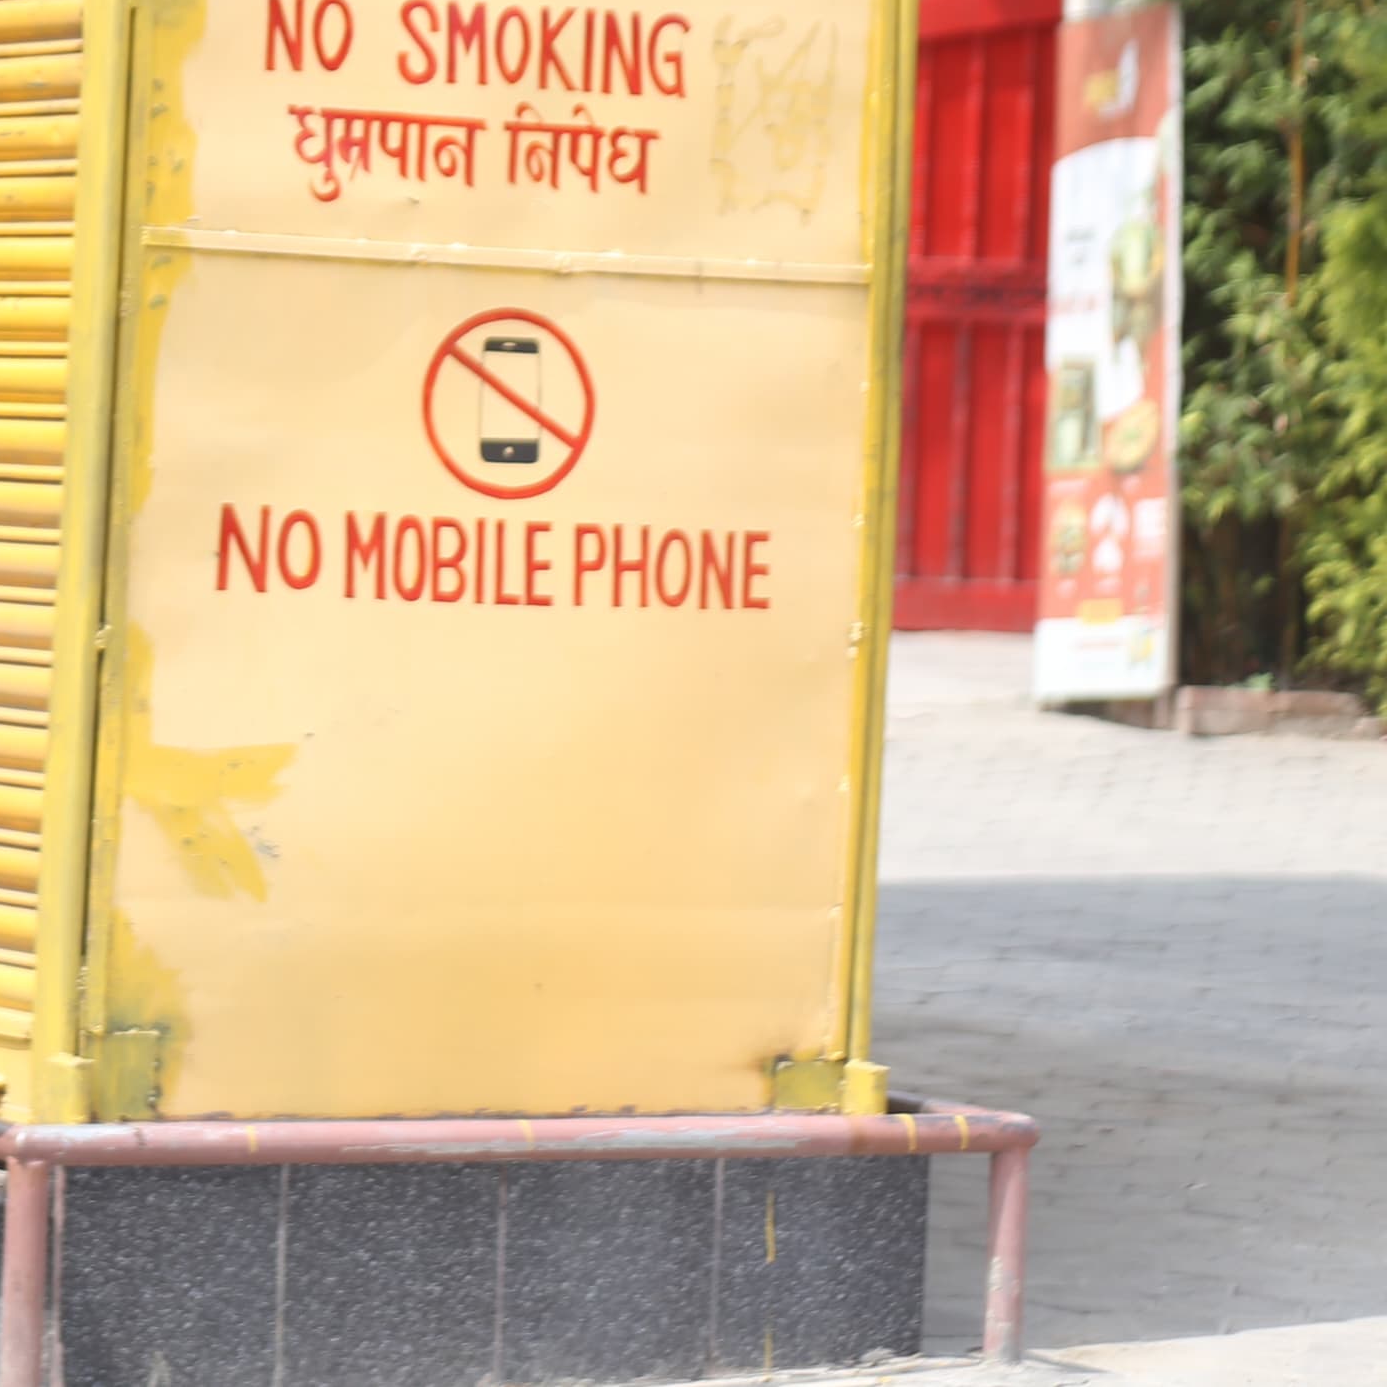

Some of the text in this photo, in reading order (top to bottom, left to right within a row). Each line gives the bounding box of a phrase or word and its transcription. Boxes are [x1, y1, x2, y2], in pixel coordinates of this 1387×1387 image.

[215, 502, 773, 611] NO MOBILE PHONE
